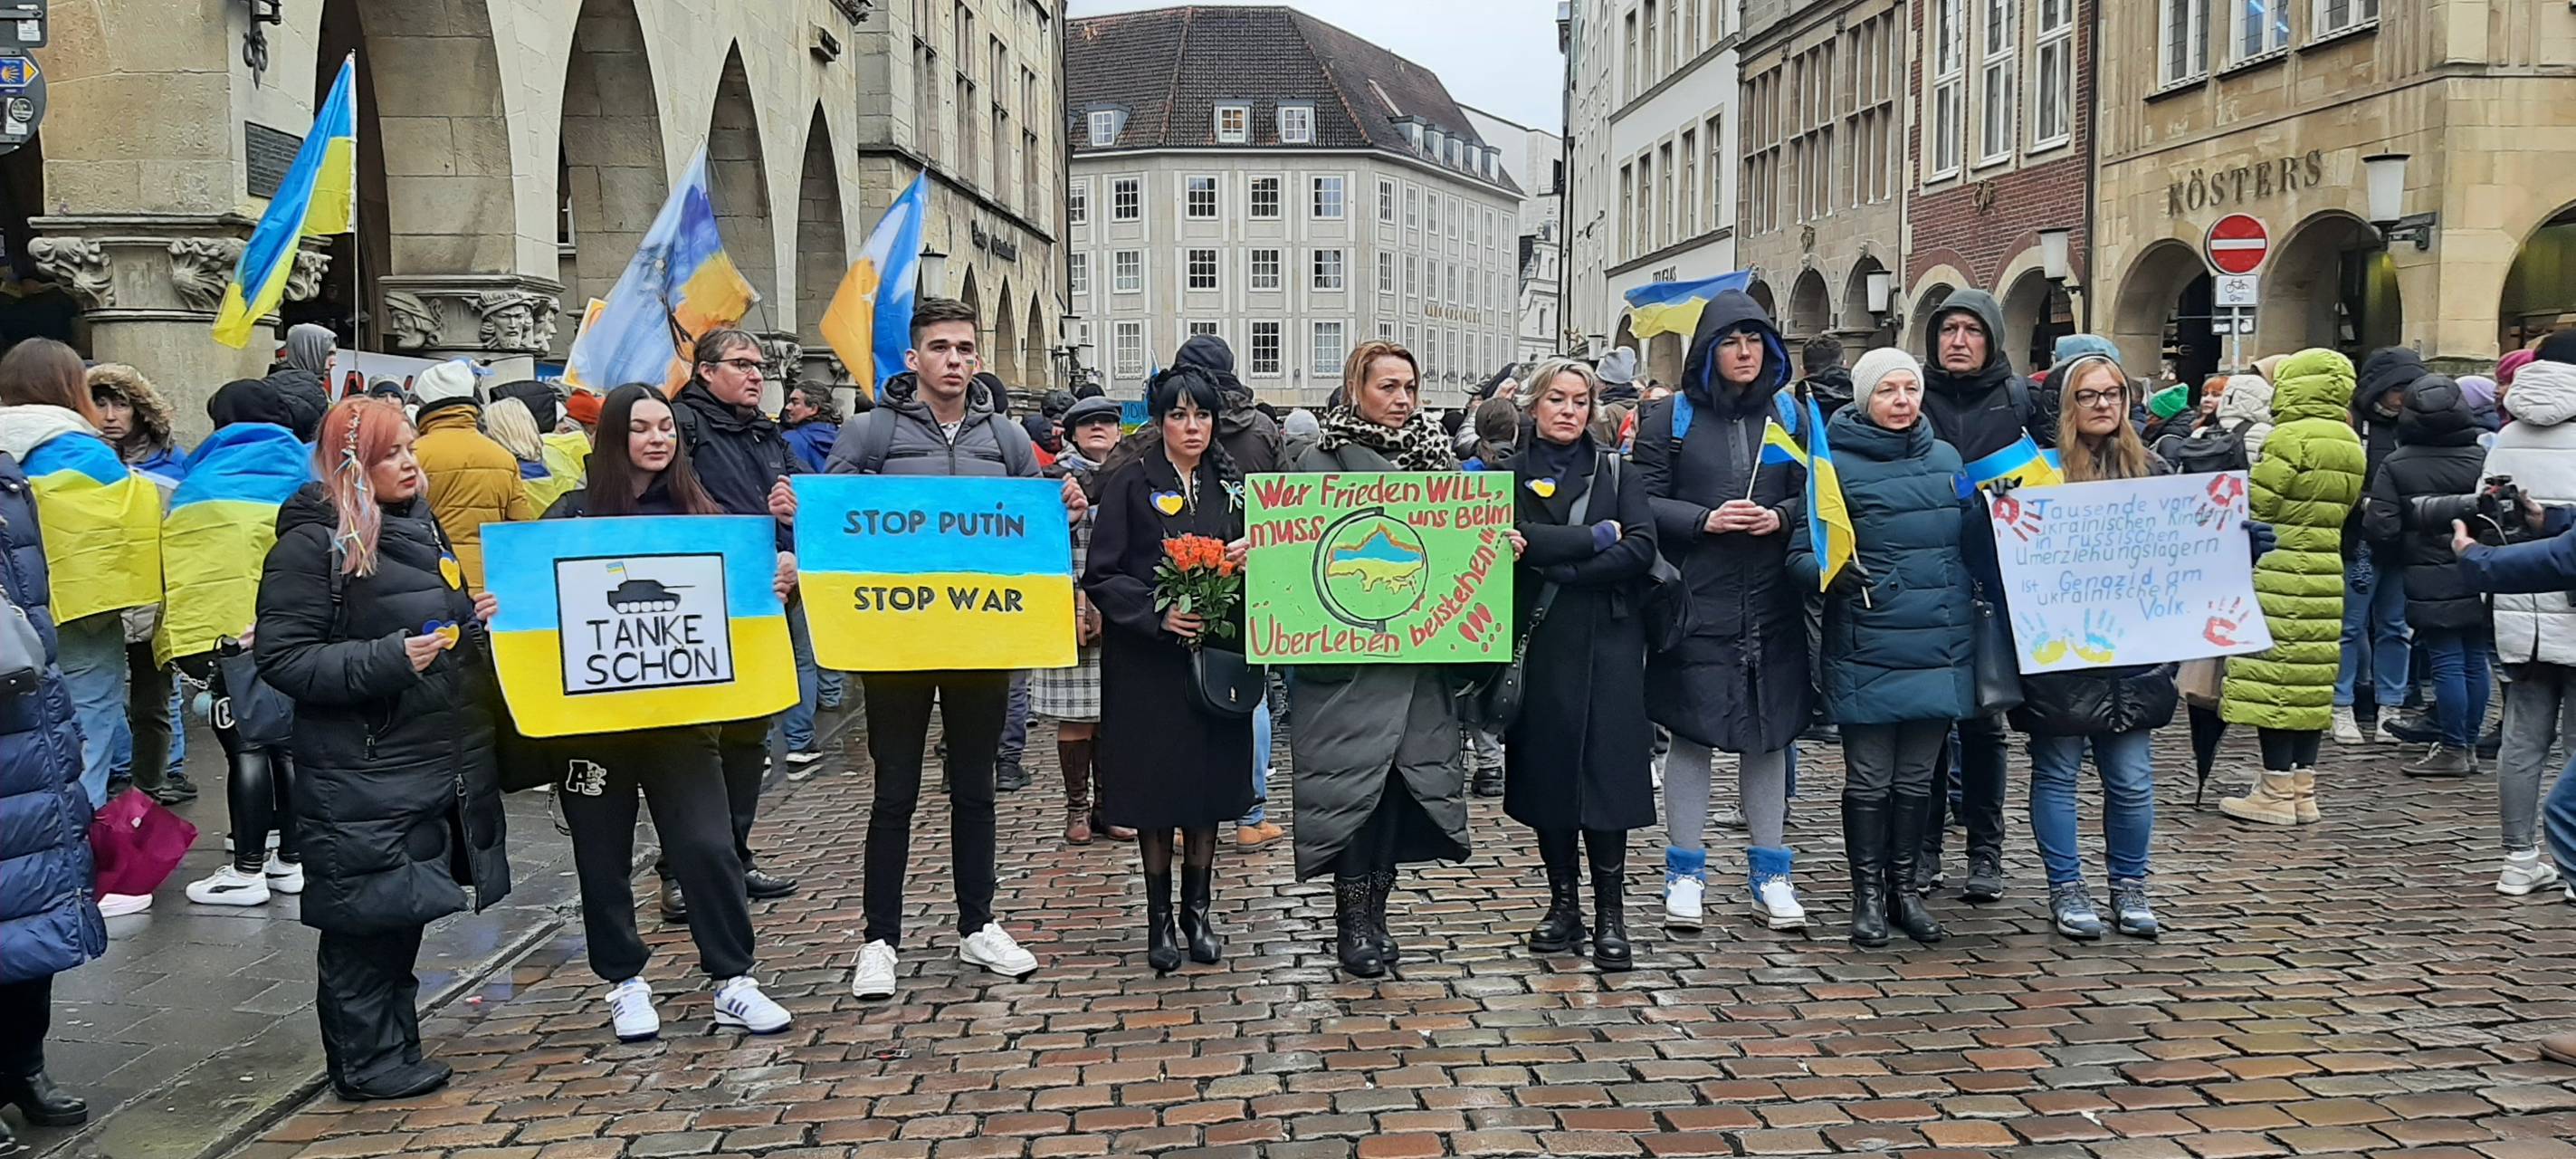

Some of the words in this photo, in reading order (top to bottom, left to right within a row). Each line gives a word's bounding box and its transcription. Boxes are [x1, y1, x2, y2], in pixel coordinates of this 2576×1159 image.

[2167, 148, 2323, 217] KÖSTERS
[1251, 475, 1312, 510] Wer
[1321, 474, 1421, 509] Frieden
[2031, 493, 2148, 520] Tausende
[843, 509, 926, 535] STOP
[1250, 515, 1325, 548] muss
[1407, 509, 1449, 528] uns
[1455, 499, 1512, 530] Beim
[2067, 528, 2180, 549] russischen
[2015, 536, 2219, 570] Umerziehungslagern
[2059, 567, 2153, 591] Genozid
[2167, 568, 2202, 585] am
[854, 586, 935, 611] STOP
[947, 586, 1023, 612] WAR
[587, 614, 704, 650] TANKE
[585, 644, 718, 685] SCHÖN
